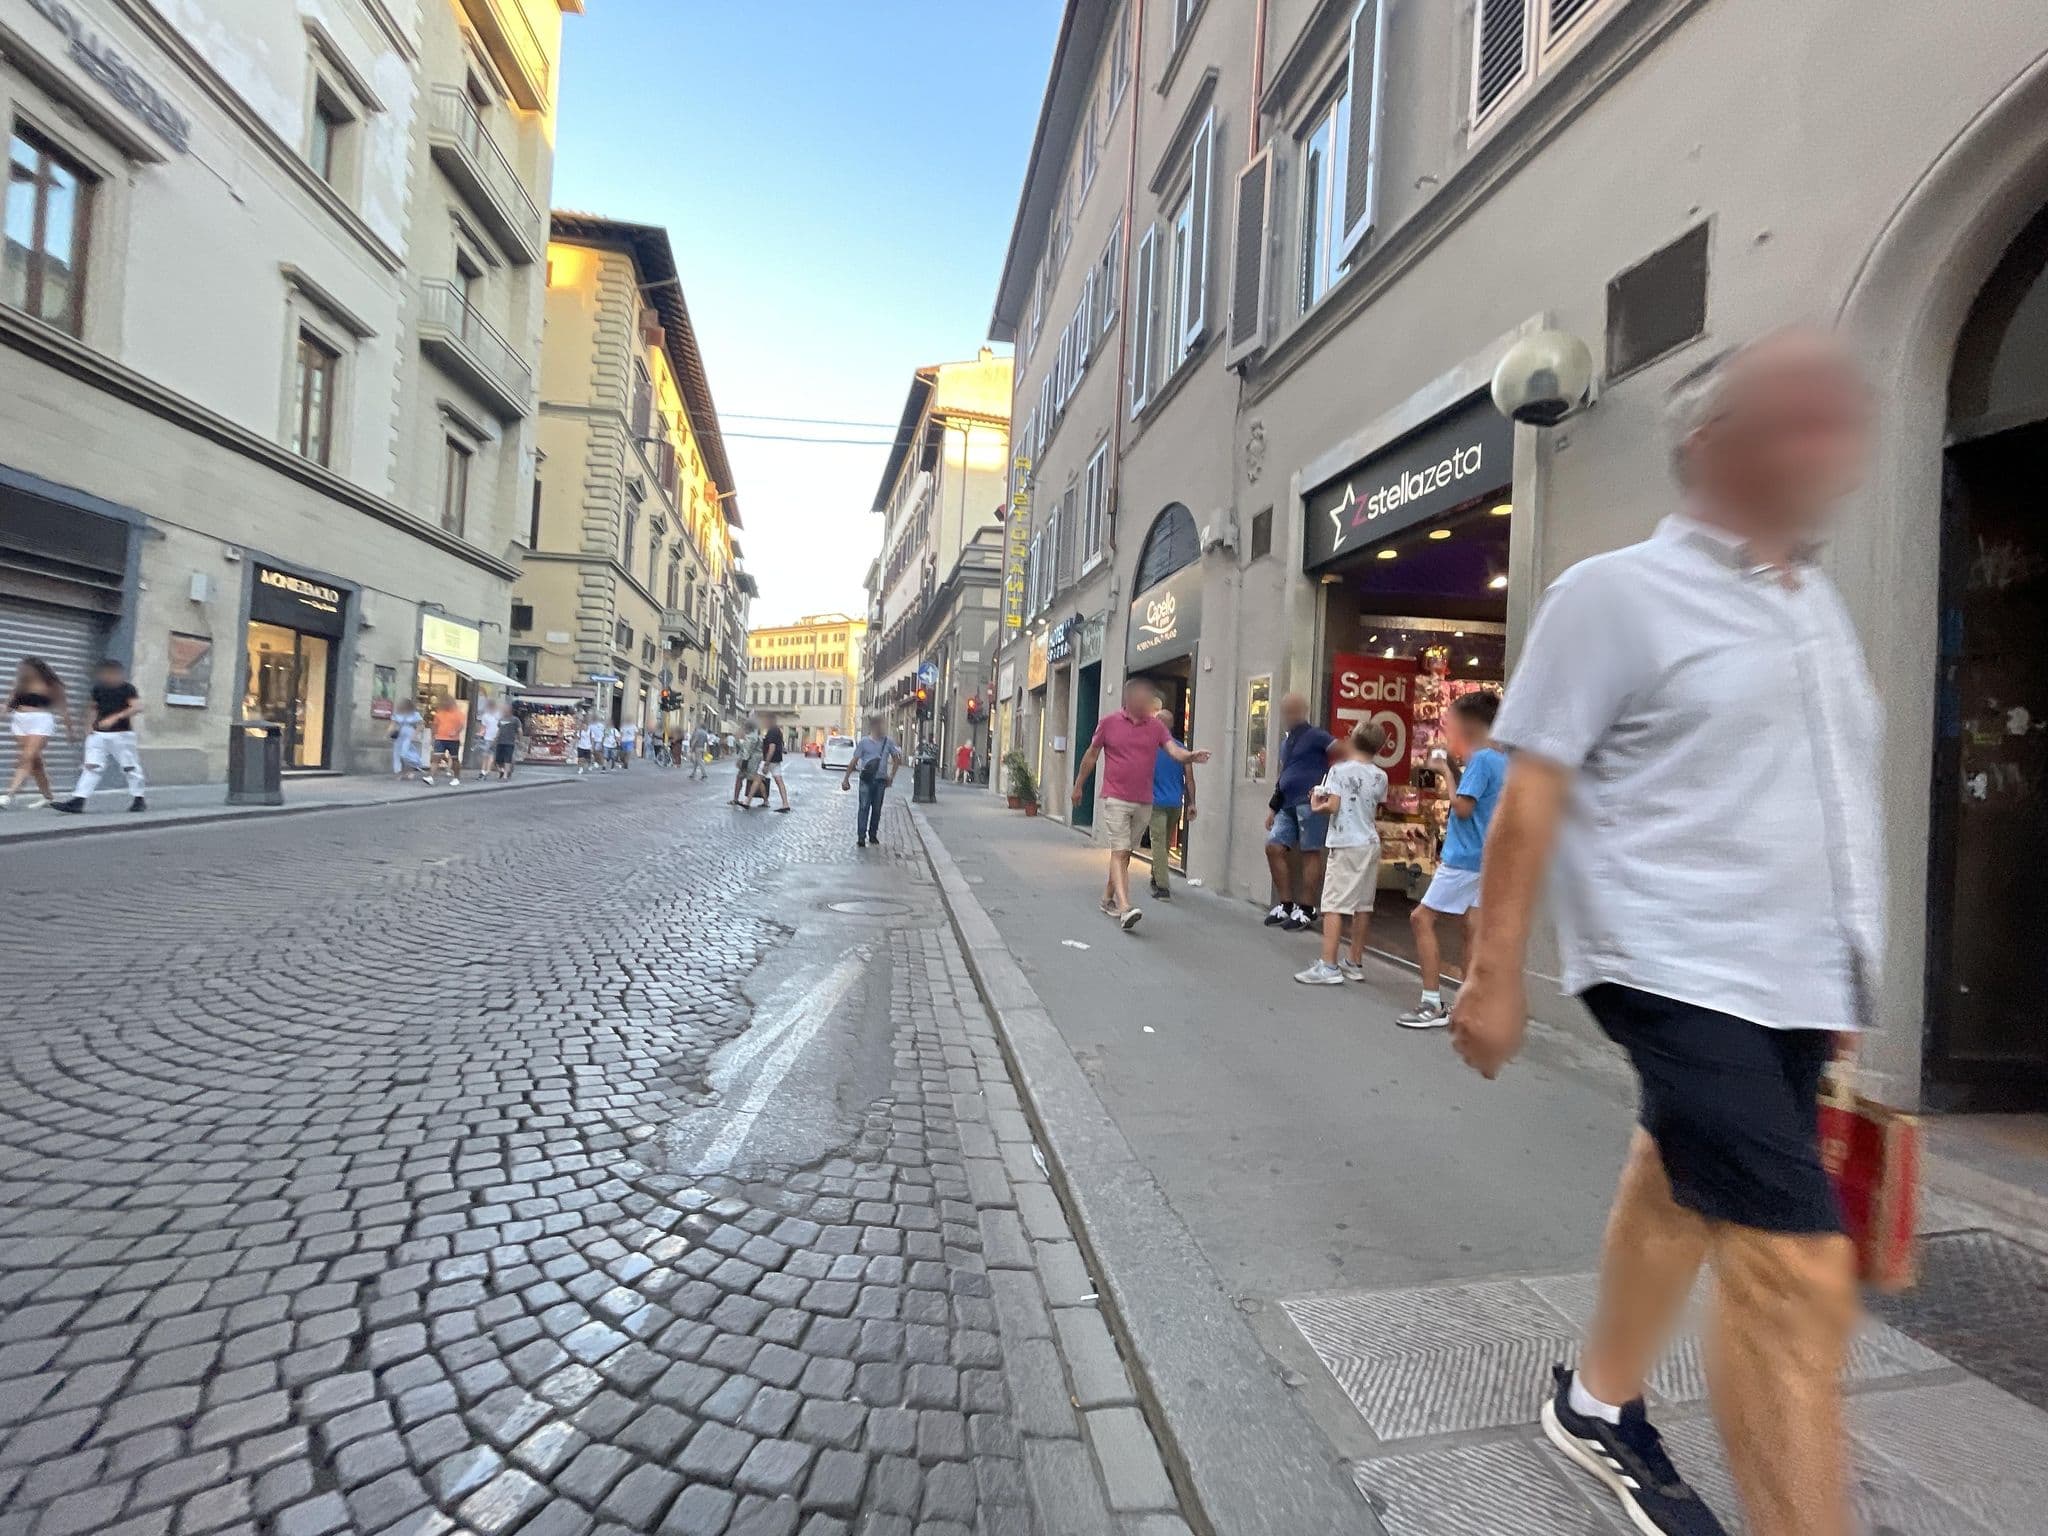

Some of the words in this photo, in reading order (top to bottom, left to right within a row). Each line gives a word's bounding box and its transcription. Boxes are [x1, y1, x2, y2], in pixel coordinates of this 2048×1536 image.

[1005, 455, 1032, 628] RISTORANTE
[1146, 591, 1176, 627] Capello
[1339, 671, 1407, 702] Saldi
